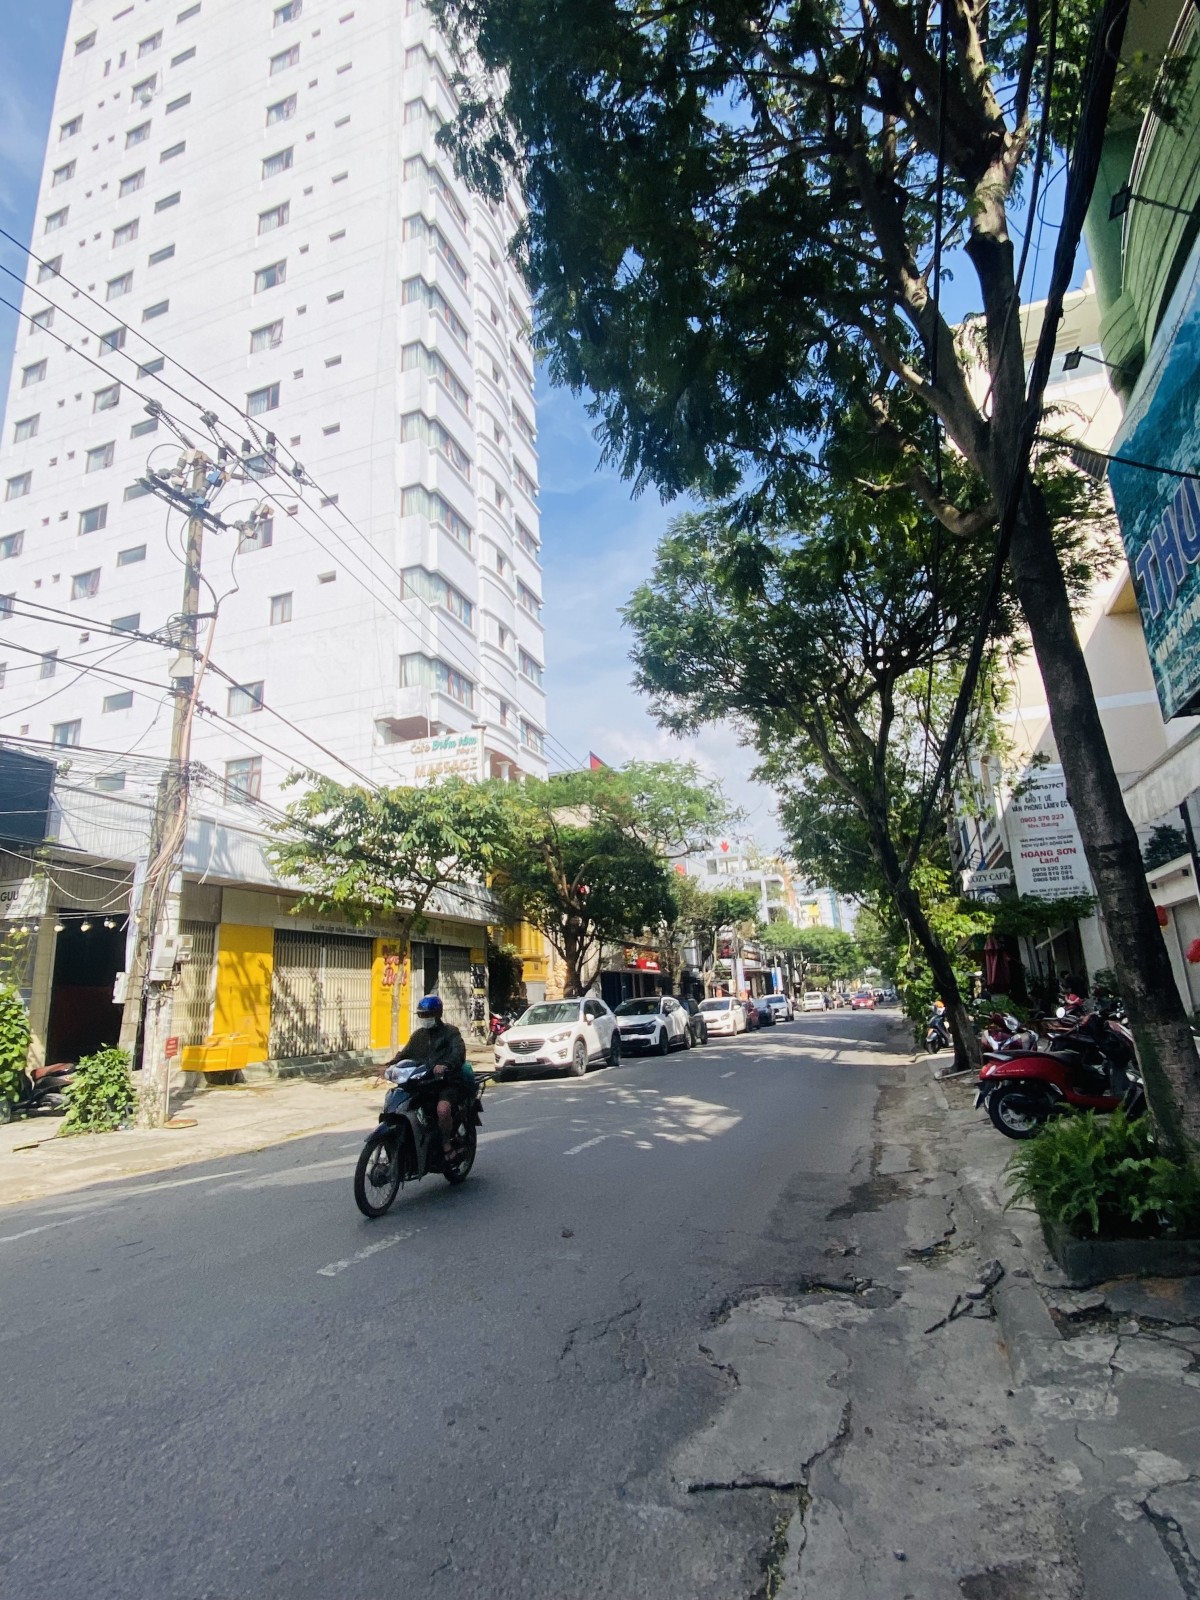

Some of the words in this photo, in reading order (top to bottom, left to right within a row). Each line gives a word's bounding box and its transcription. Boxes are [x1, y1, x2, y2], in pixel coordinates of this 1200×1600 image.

[1052, 813, 1065, 821] 223
[1020, 849, 1054, 859] HOÀNG
[1056, 847, 1077, 856] SƠN
[1039, 856, 1060, 864] Land
